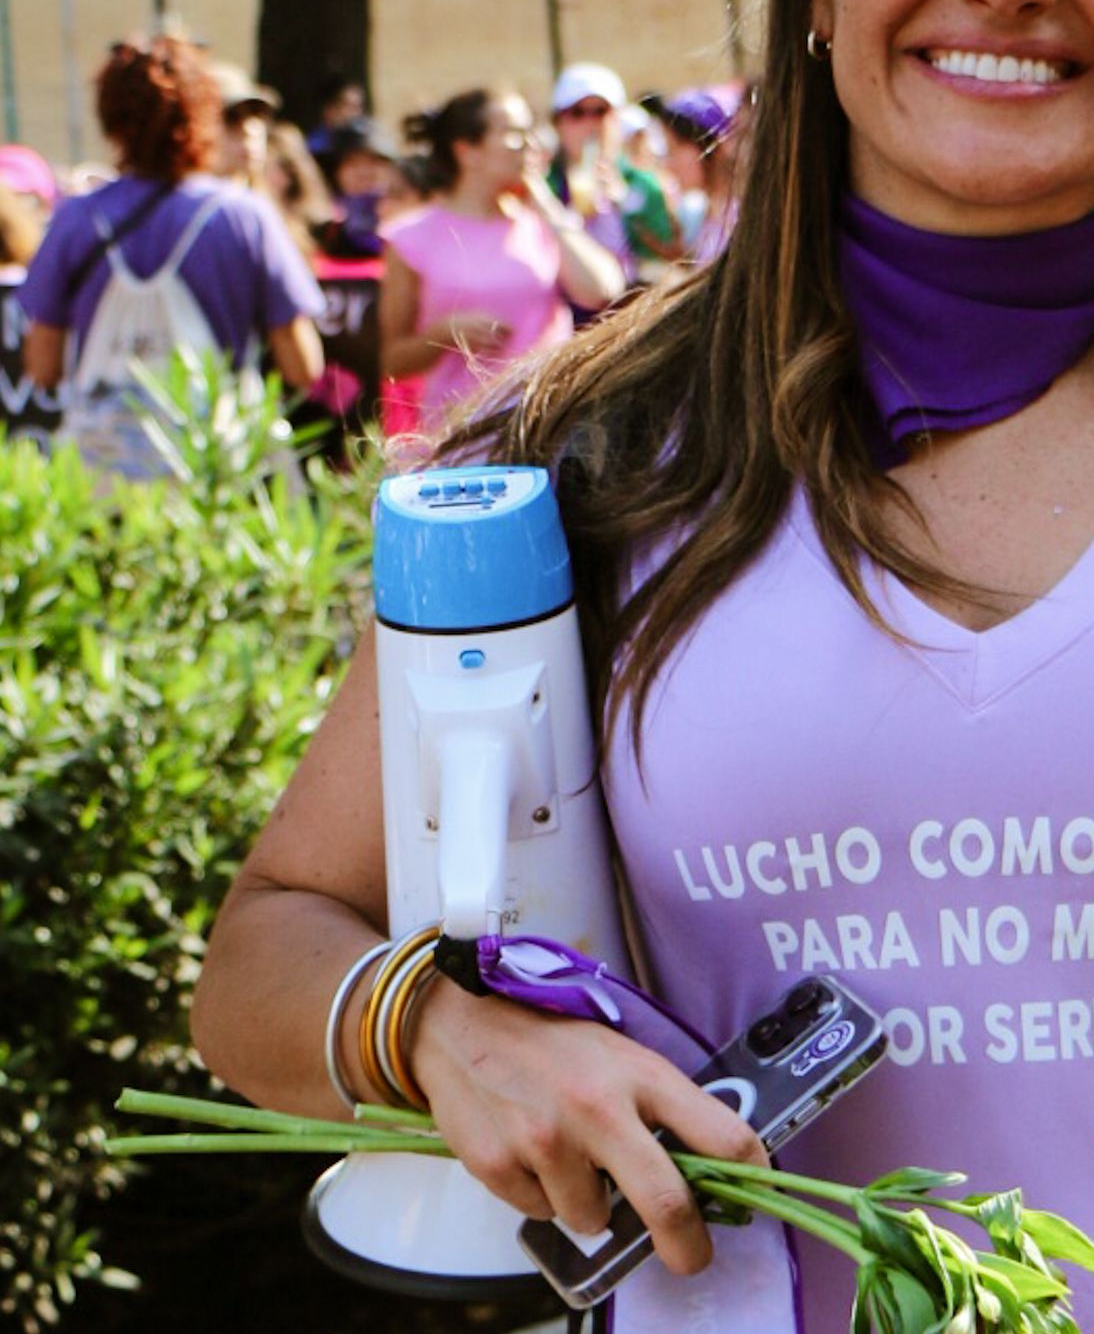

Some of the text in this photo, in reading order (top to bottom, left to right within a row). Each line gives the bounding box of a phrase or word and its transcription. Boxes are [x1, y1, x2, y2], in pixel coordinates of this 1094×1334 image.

[671, 826, 882, 902] LUCHO
[762, 911, 921, 973] PARA
[939, 906, 1030, 967] NO
[883, 1005, 968, 1067] OR
